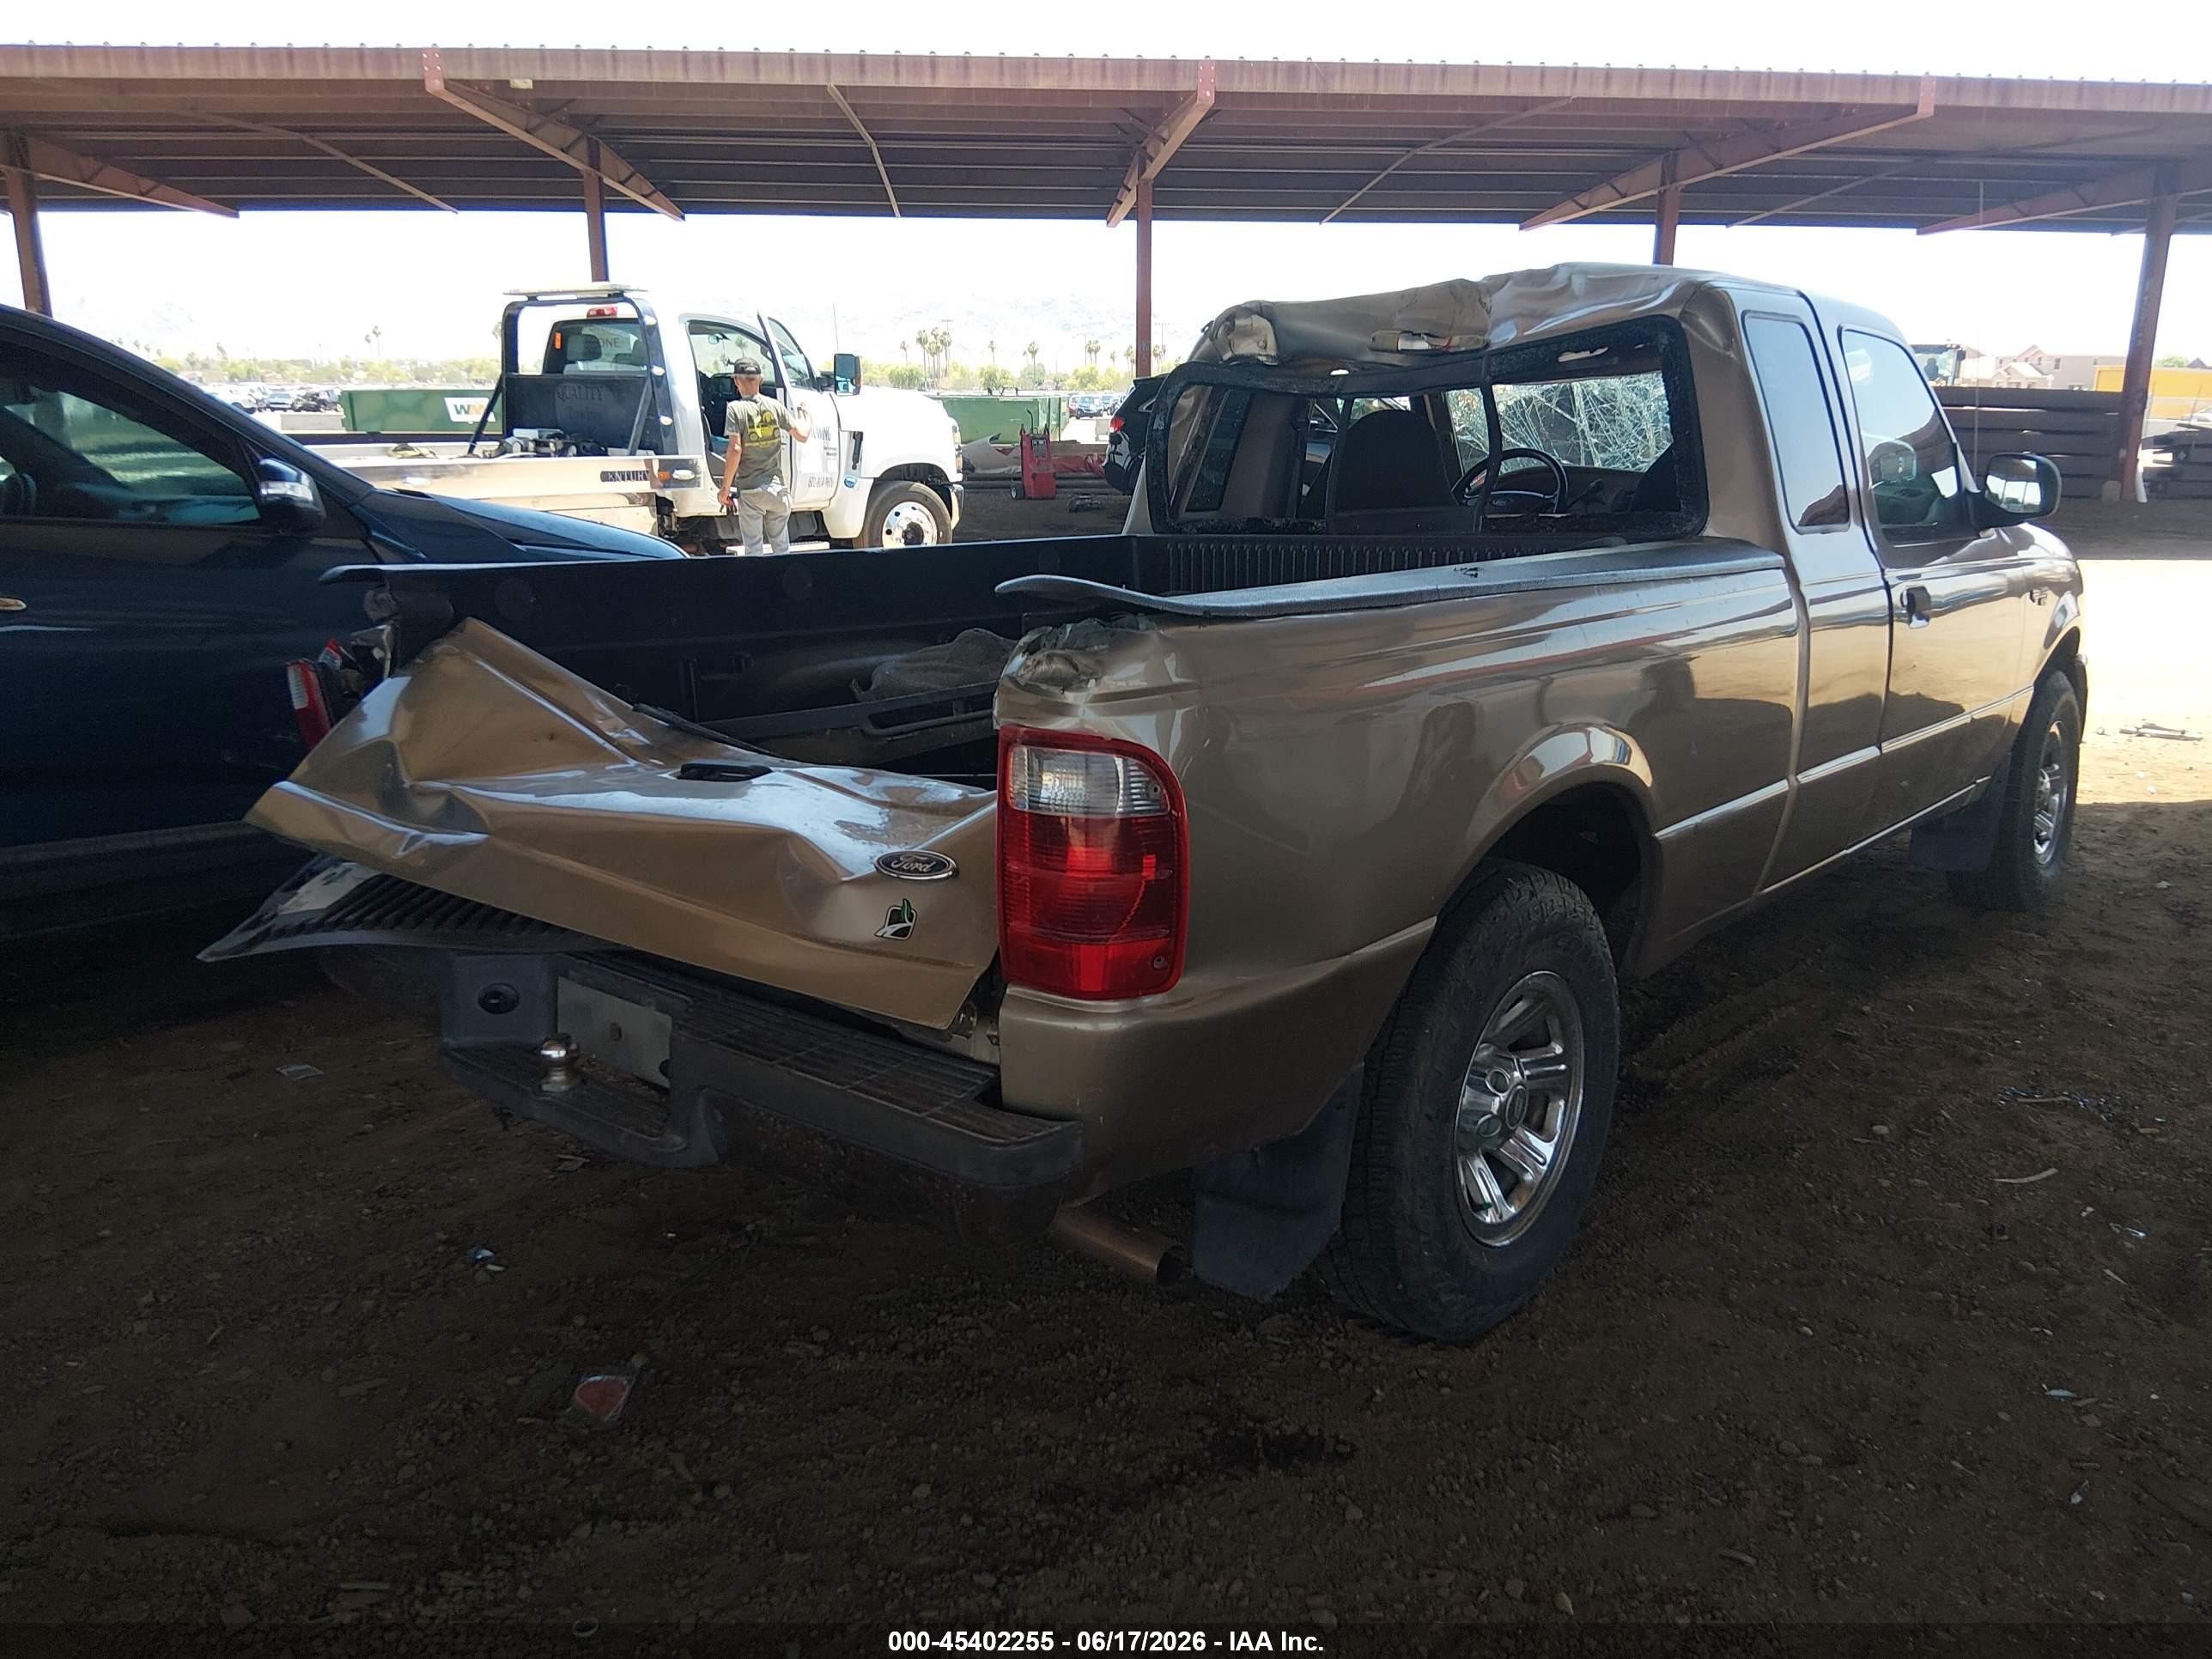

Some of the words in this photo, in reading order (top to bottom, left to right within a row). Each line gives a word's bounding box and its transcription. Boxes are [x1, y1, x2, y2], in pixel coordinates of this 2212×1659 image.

[556, 384, 605, 402] QUALITY
[602, 471, 650, 481] ENTURY
[890, 854, 937, 872] Ford
